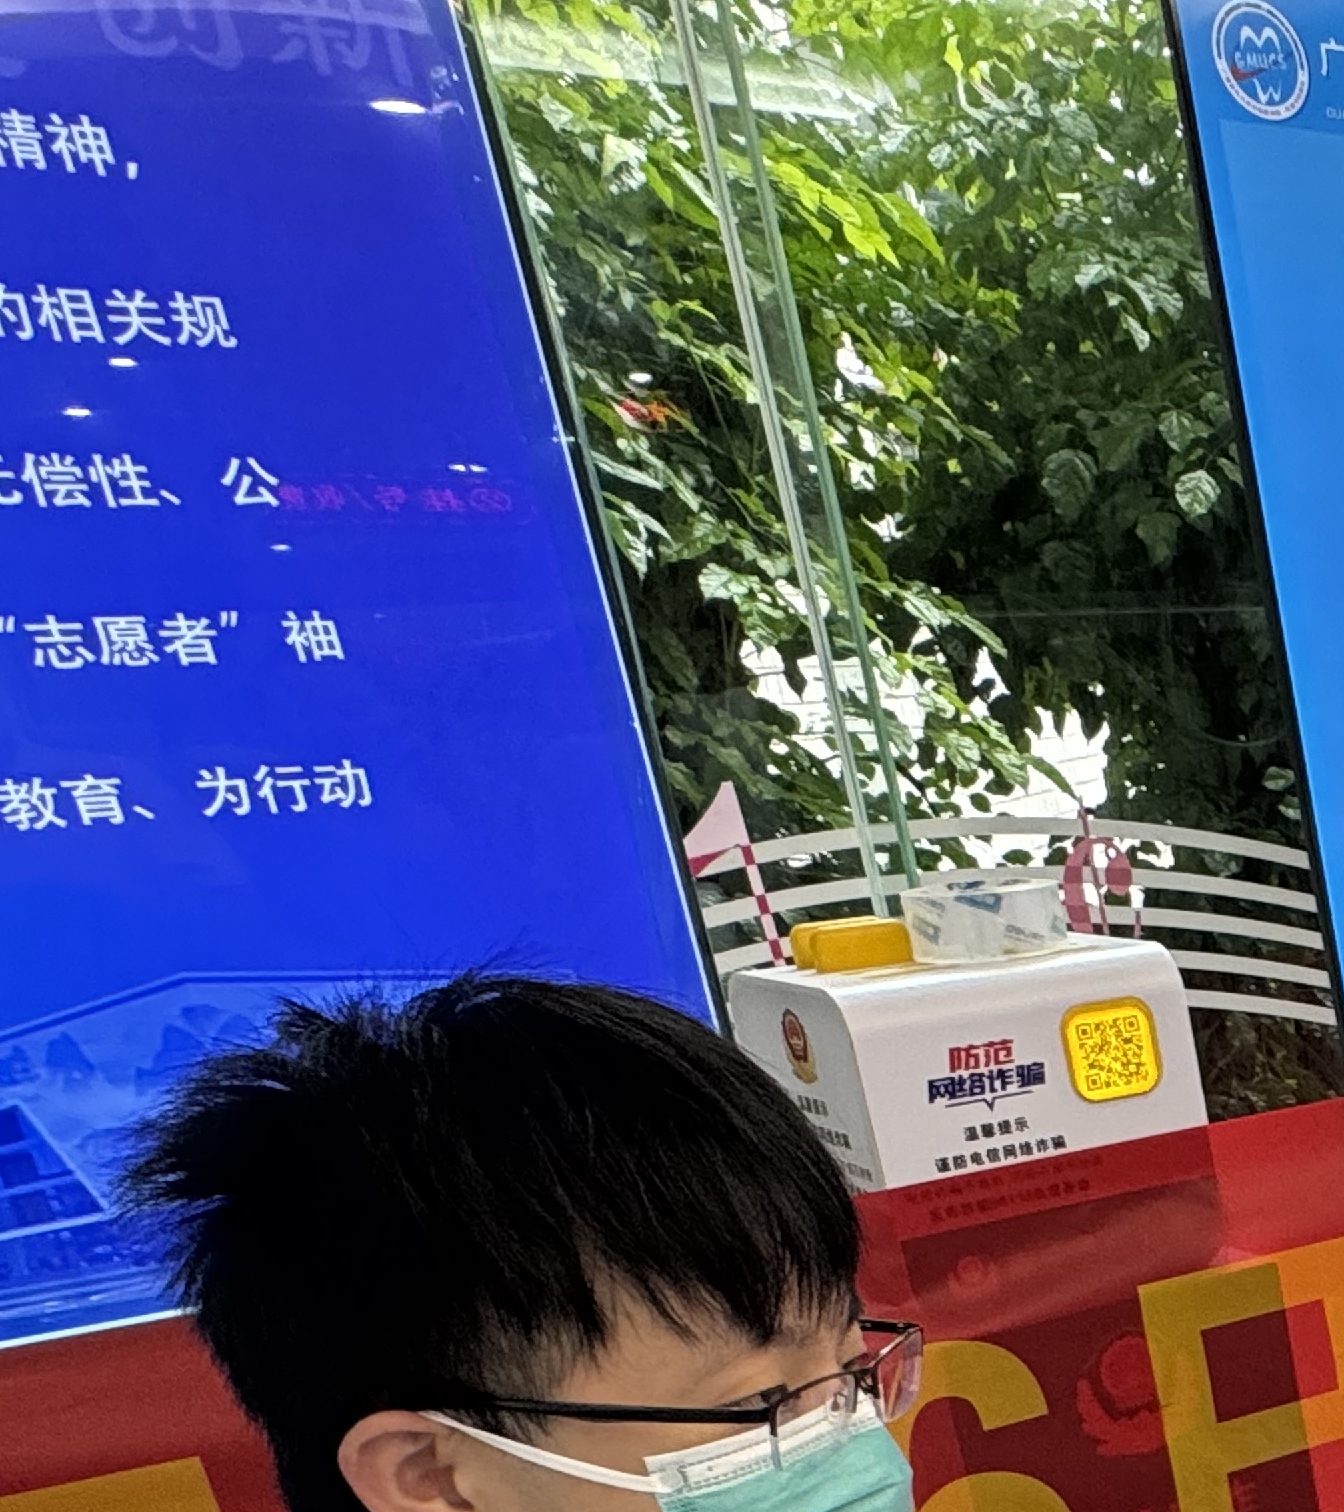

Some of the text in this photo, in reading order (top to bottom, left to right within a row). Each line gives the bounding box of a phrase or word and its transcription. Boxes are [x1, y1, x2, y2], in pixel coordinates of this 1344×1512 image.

[0, 450, 282, 509] 偿性、公
[2, 760, 374, 832] 教育、为行动
[948, 1038, 1015, 1074] 防范
[927, 1062, 1046, 1104] 网络诈骗
[963, 1116, 1030, 1143] 温馨提示
[935, 1135, 1067, 1173] 谨防电信网络诈骗
